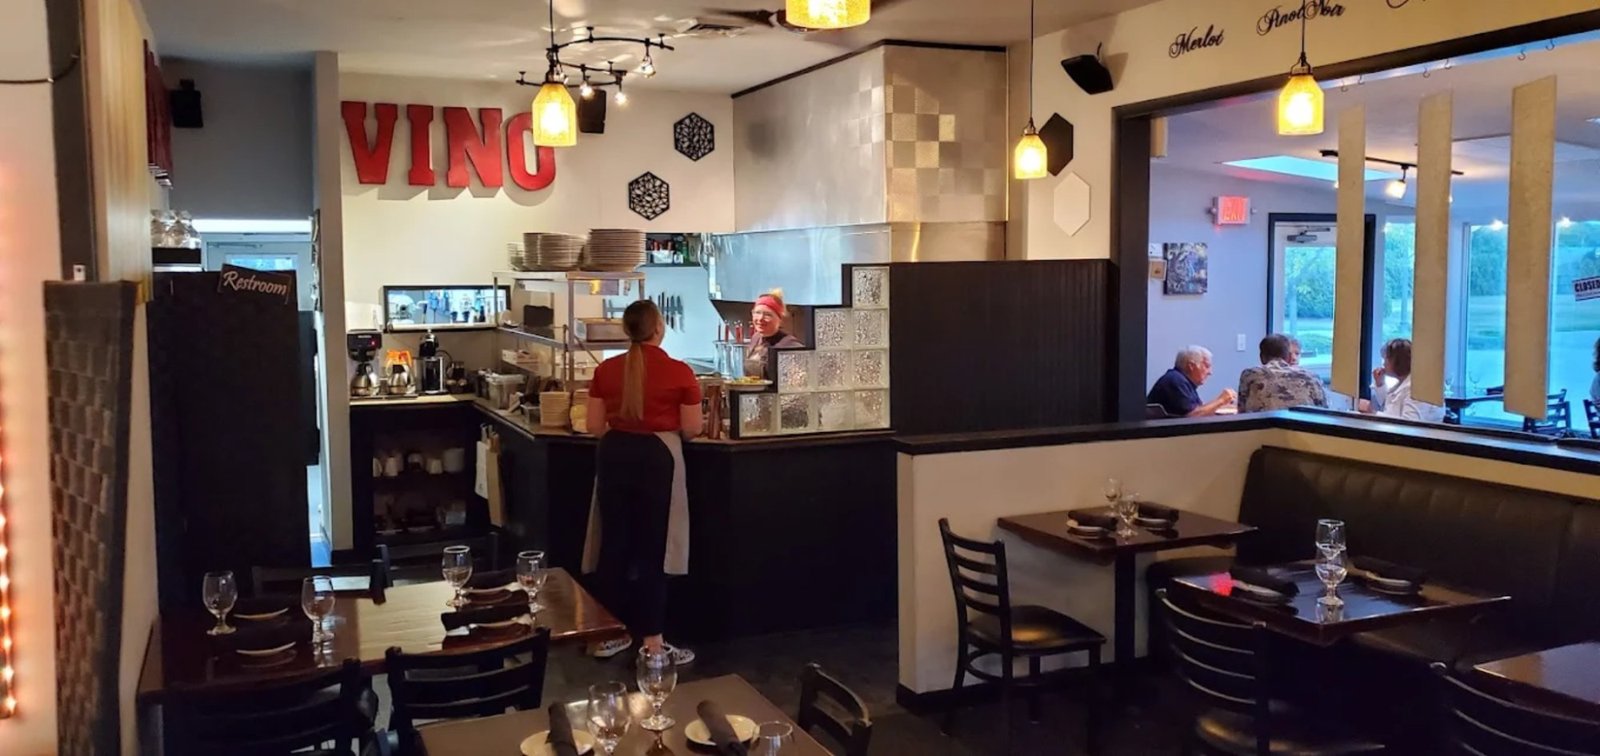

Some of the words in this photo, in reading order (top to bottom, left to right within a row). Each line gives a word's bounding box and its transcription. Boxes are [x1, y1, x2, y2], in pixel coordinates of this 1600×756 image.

[1256, 5, 1305, 36] Pinot
[1303, 0, 1346, 20] Noir
[1168, 24, 1224, 58] Merlot
[341, 101, 556, 191] VINO
[223, 270, 287, 295] Restroom
